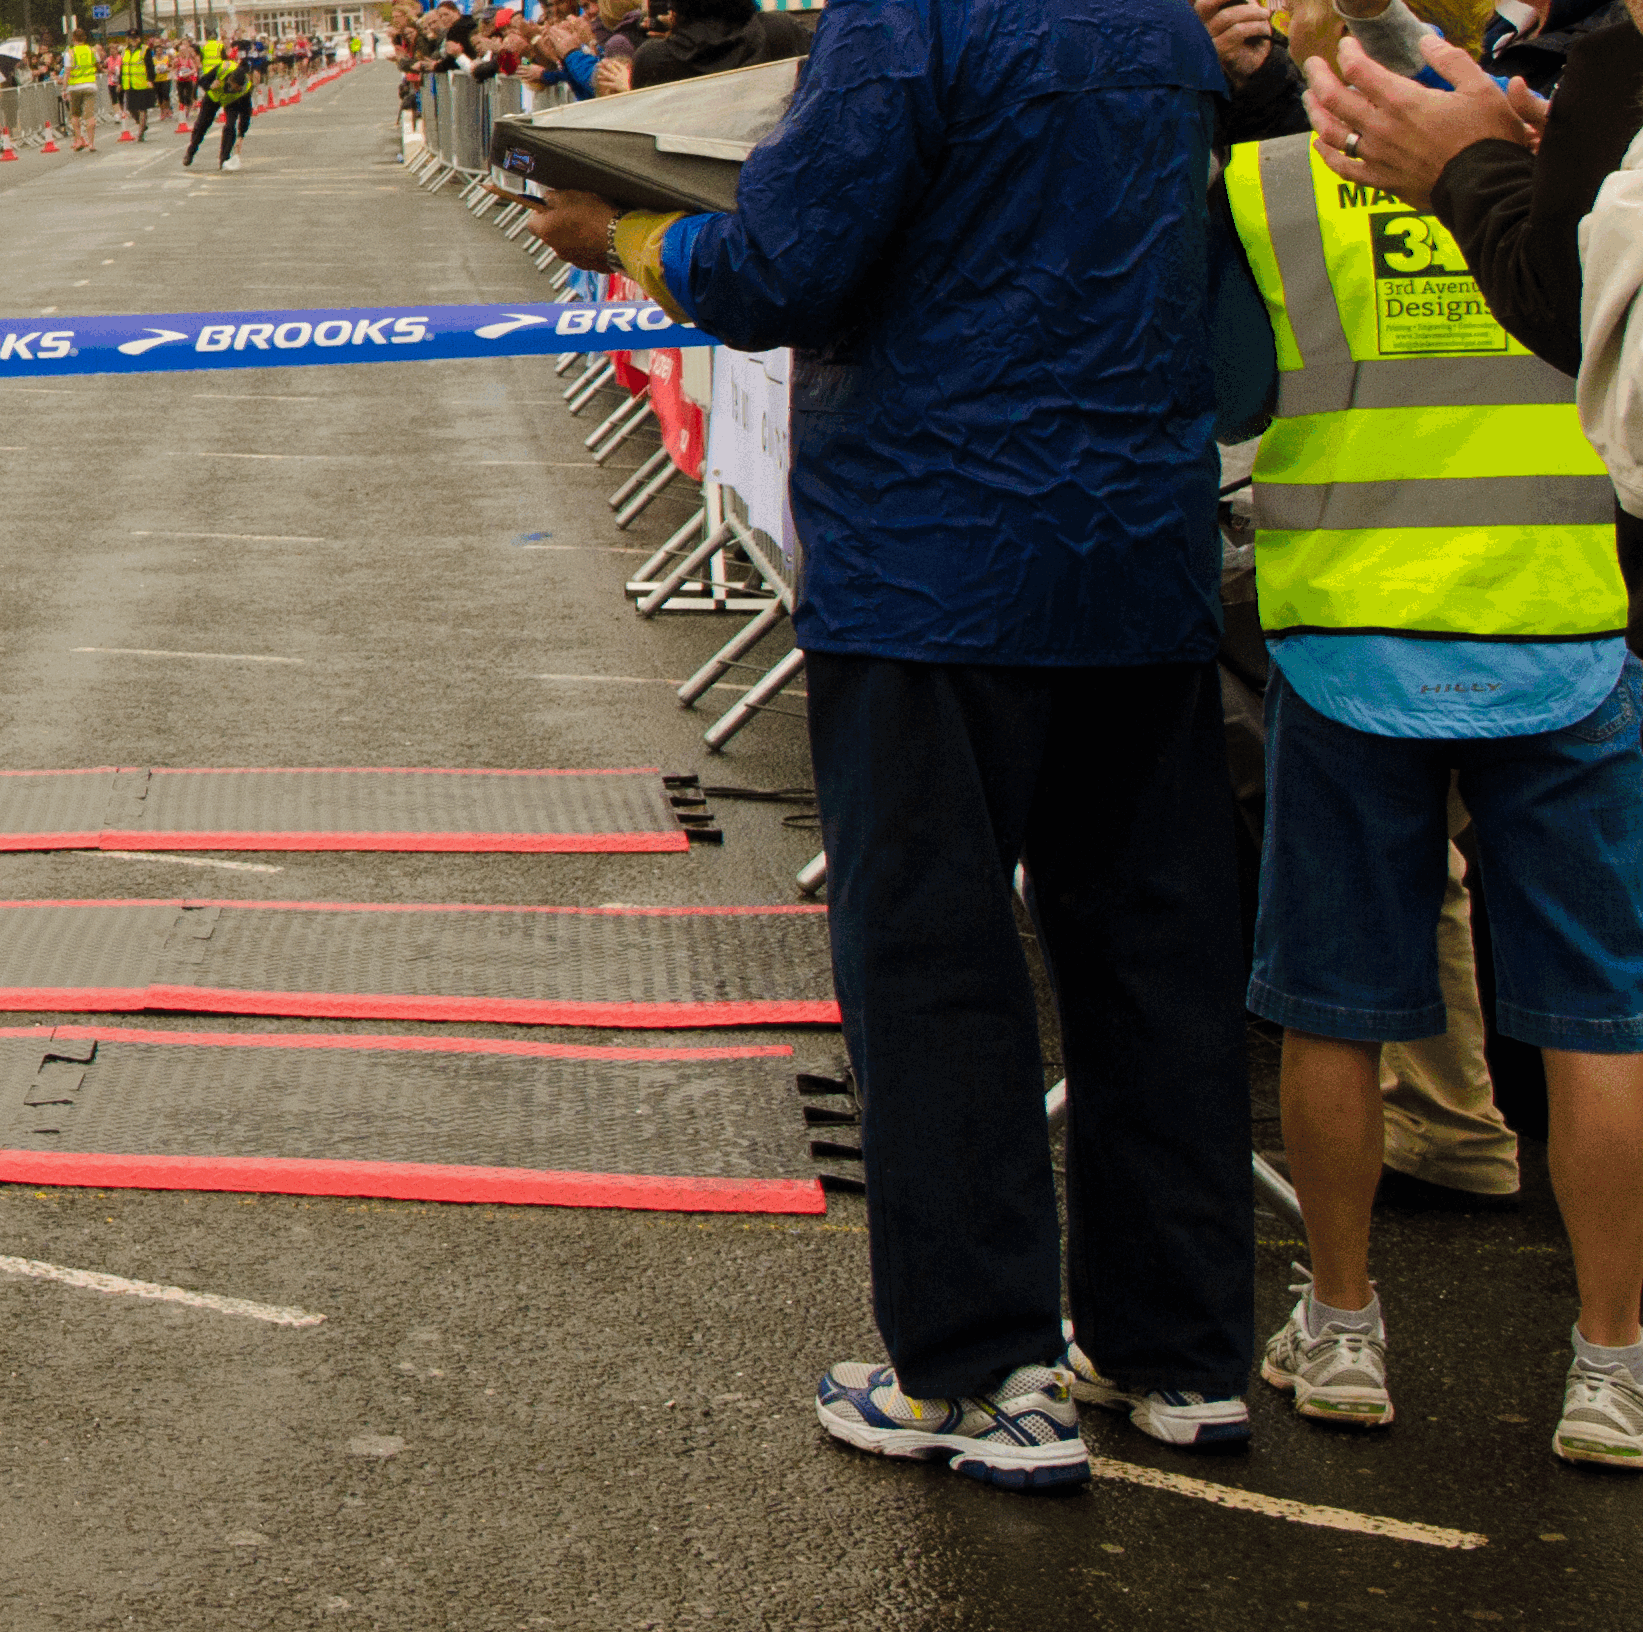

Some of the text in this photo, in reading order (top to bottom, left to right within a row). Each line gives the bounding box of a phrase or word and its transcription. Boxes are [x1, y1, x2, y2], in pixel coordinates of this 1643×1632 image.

[1337, 183, 1402, 209] MA
[1383, 280, 1414, 296] 3rd
[195, 316, 430, 352] BROOKS
[555, 304, 699, 335] BRO
